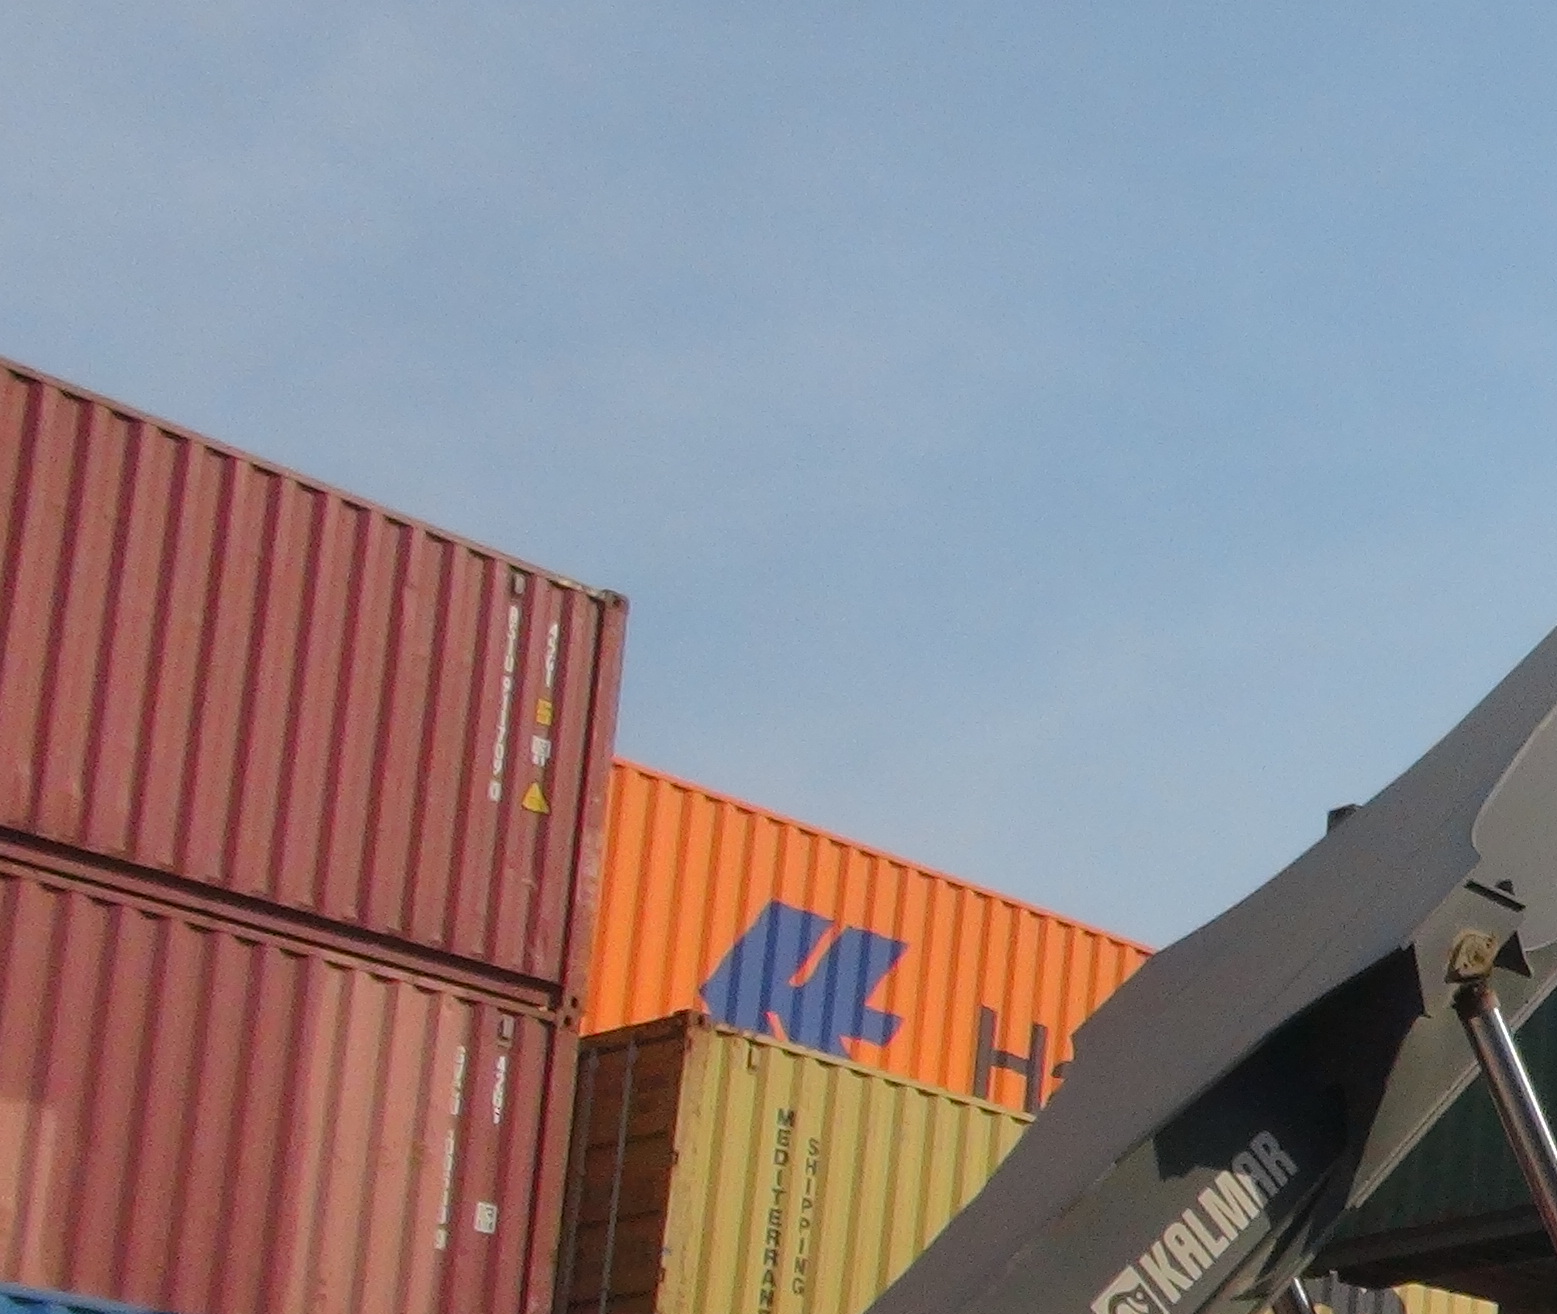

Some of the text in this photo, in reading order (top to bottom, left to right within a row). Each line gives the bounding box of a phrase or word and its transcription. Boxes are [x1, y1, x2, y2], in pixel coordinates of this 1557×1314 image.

[974, 1005, 1075, 1113] H
[792, 1137, 819, 1295] SHIPPING
[1138, 1130, 1298, 1305] KALMAR
